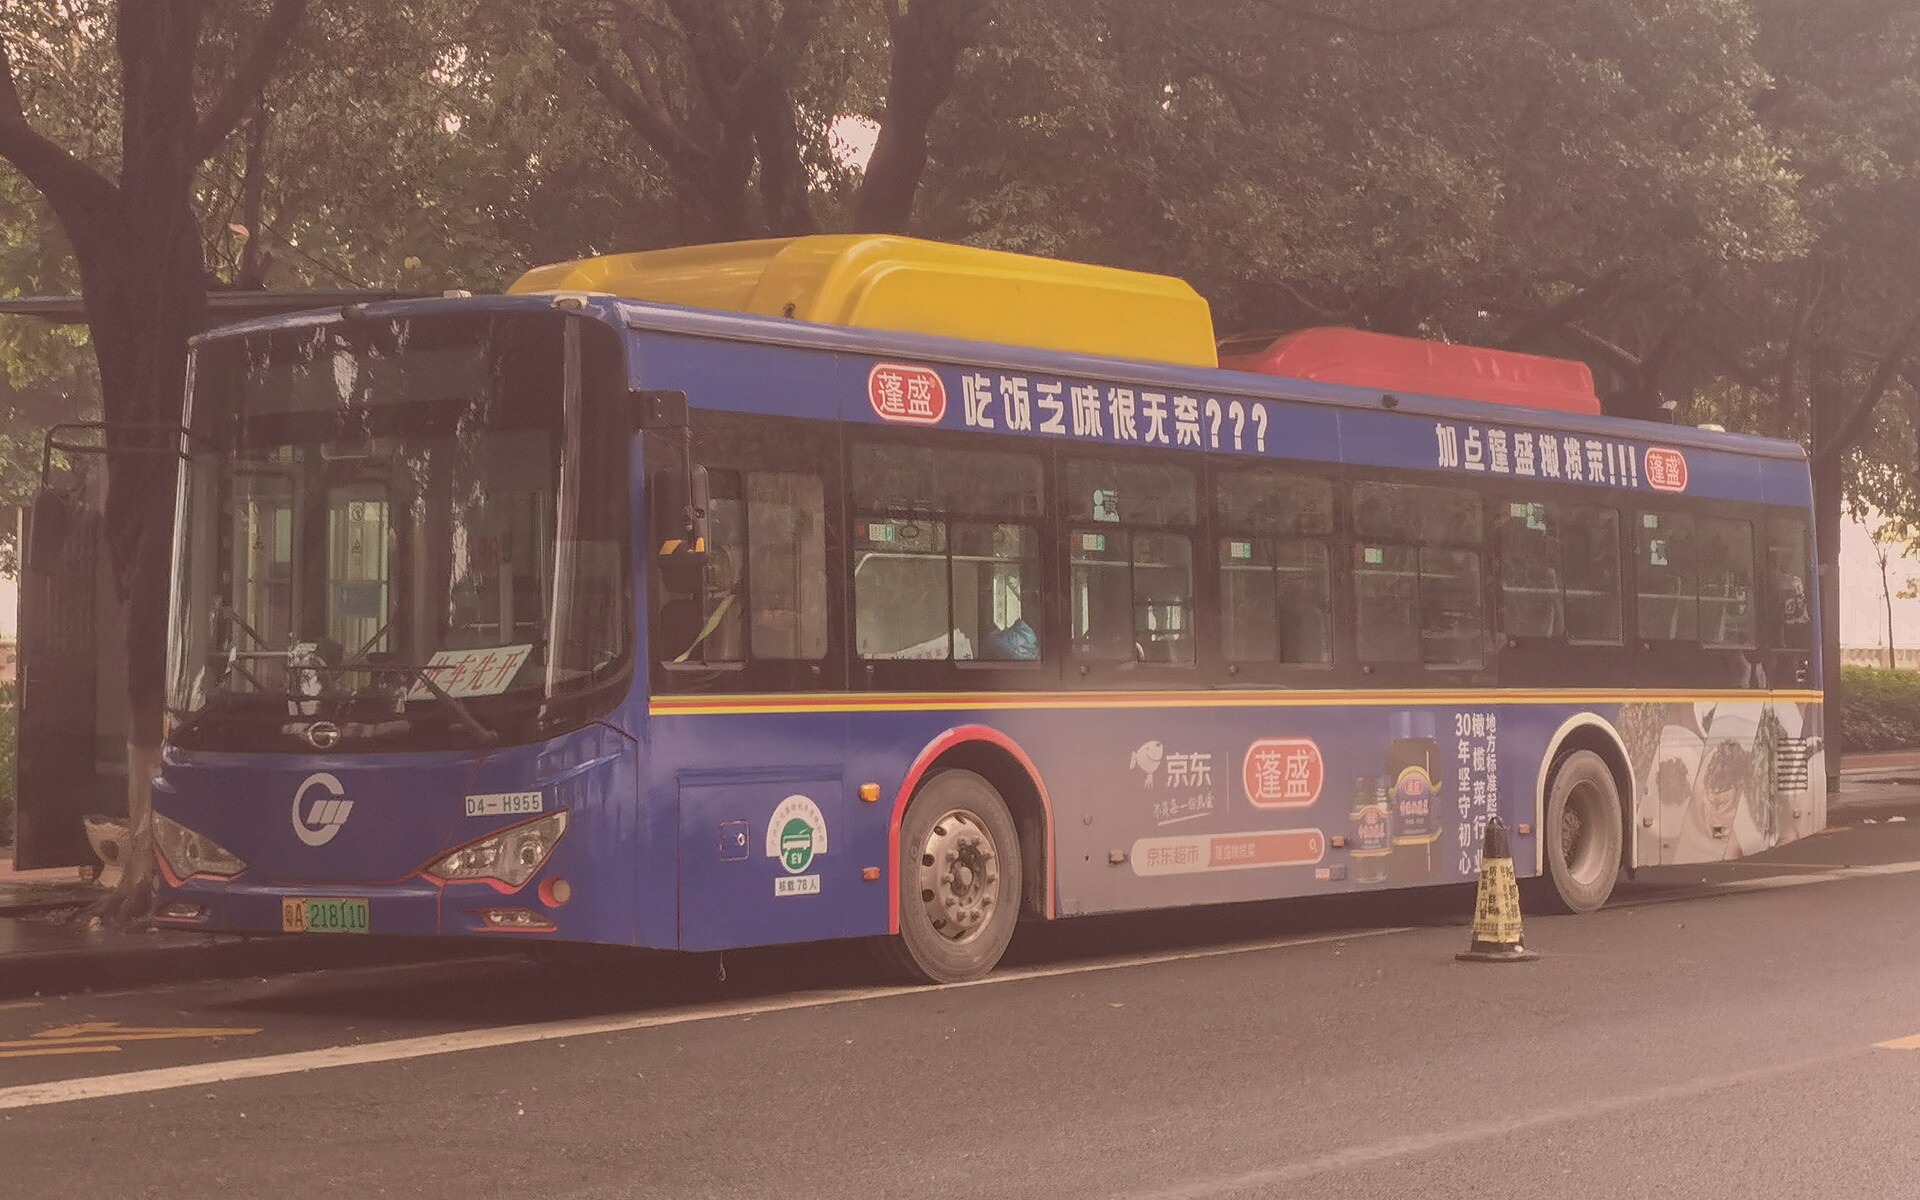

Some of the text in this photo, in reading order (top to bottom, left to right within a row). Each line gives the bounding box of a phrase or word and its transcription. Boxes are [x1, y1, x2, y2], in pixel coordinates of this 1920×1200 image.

[876, 372, 934, 417] 蓬盛
[961, 373, 1268, 453] 吃饭乏味很无奈???
[1166, 752, 1212, 789] 京东
[1255, 750, 1312, 800] 蓬盛
[467, 797, 541, 815] D4-H955
[1455, 713, 1471, 875] 30年坚守初心
[1147, 845, 1199, 867] 京东超市
